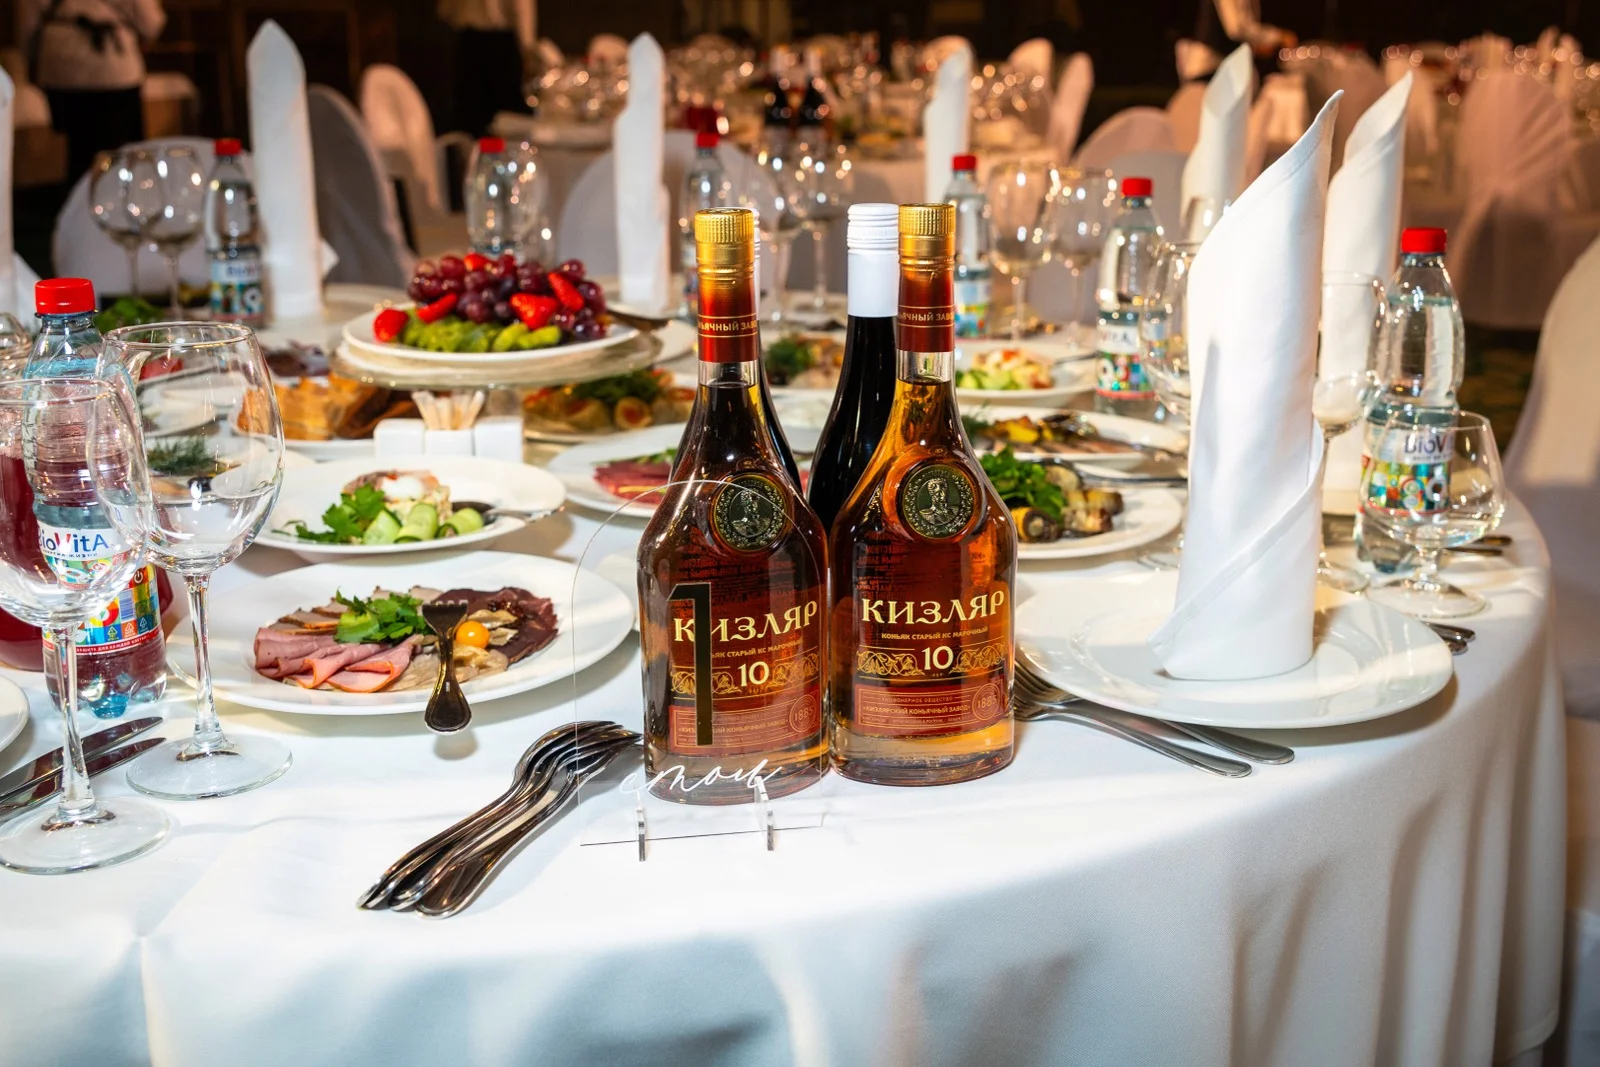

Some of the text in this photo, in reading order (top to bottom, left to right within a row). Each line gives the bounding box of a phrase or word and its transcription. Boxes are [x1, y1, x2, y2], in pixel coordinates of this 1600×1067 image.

[861, 590, 1005, 625] КИЗЛЯР
[881, 632, 910, 640] КОНЬЯК
[911, 631, 941, 640] СТАРЫЙ
[952, 625, 988, 638] МАРОЧНЫЙ
[727, 647, 756, 659] СТАРЫЙ
[757, 647, 767, 655] КС
[768, 636, 803, 653] МАРОЧНЫЙ
[921, 645, 954, 671] 10
[666, 582, 712, 746] 1
[737, 660, 770, 688] 10
[909, 706, 948, 715] КОНЬЯЧНЫЙ
